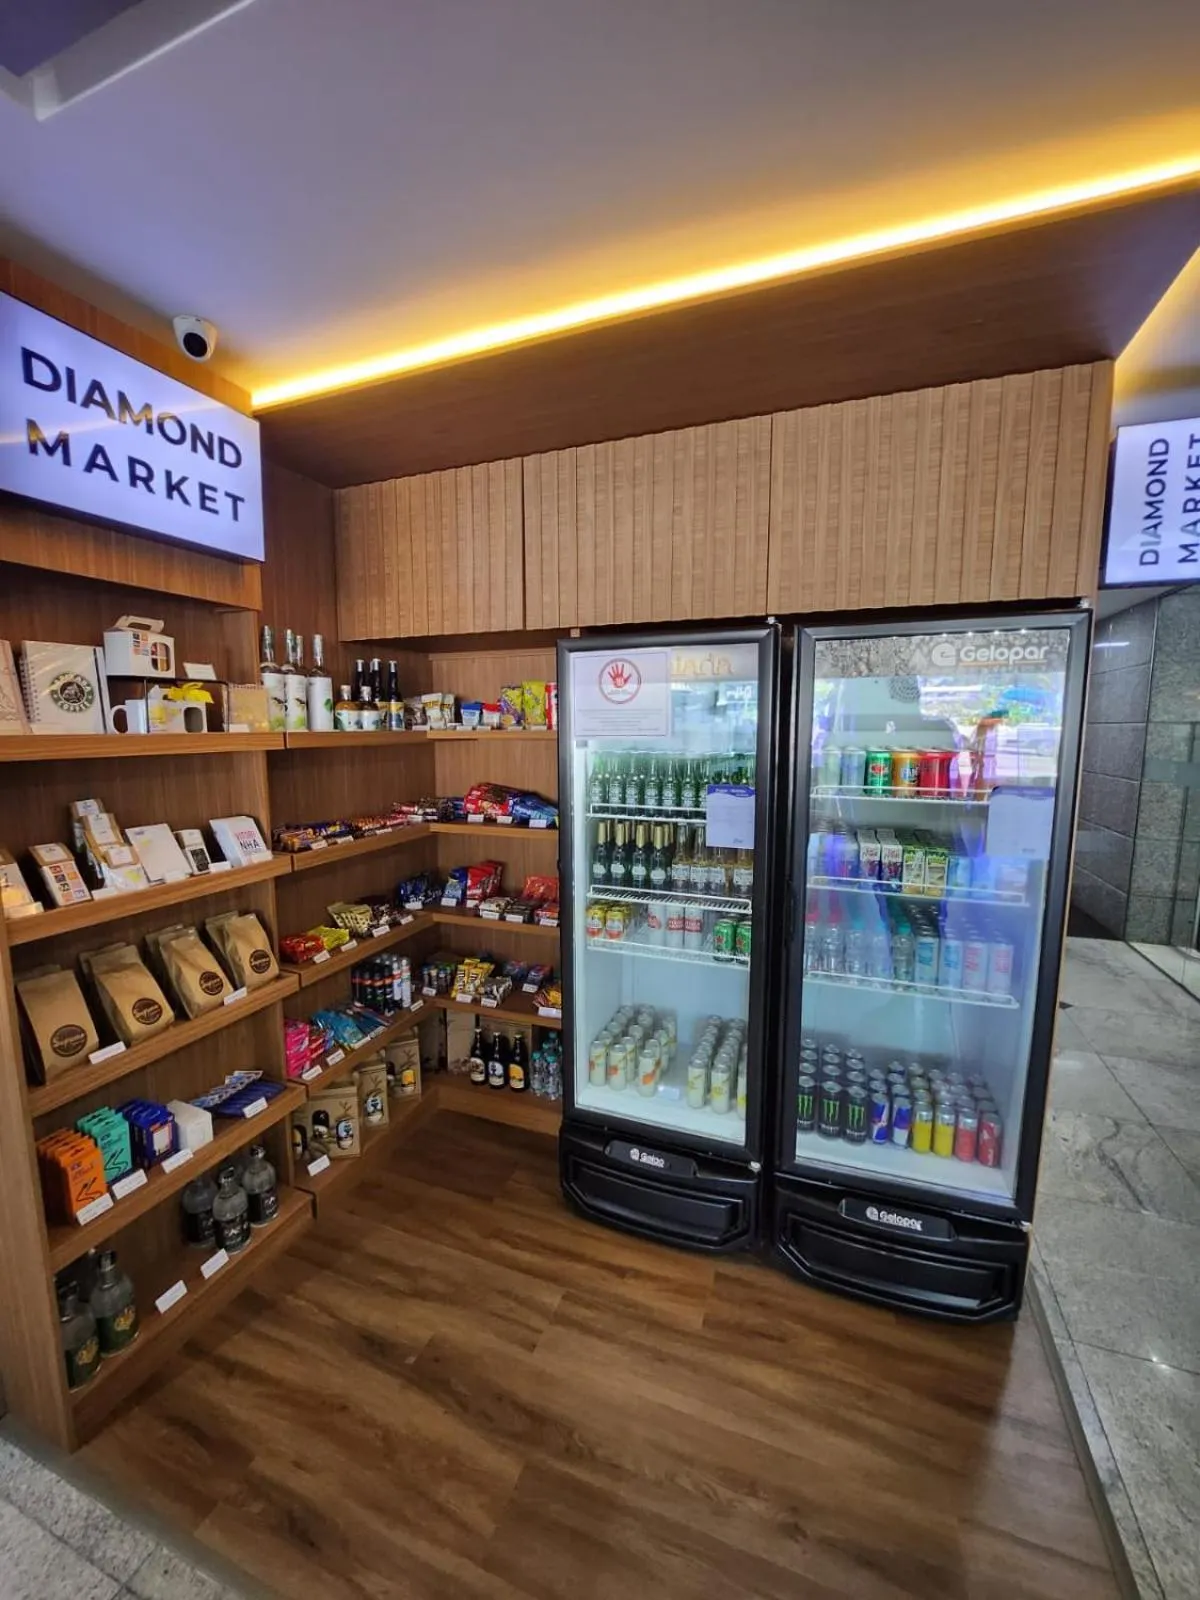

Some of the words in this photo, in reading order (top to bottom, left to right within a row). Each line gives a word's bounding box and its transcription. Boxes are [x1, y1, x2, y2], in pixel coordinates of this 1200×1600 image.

[21, 346, 242, 468] DIAMOND
[26, 418, 245, 522] MARKET
[1139, 438, 1170, 566] DIAMOND
[959, 644, 1049, 665] Gelopar
[880, 1210, 923, 1231] Gelopar
